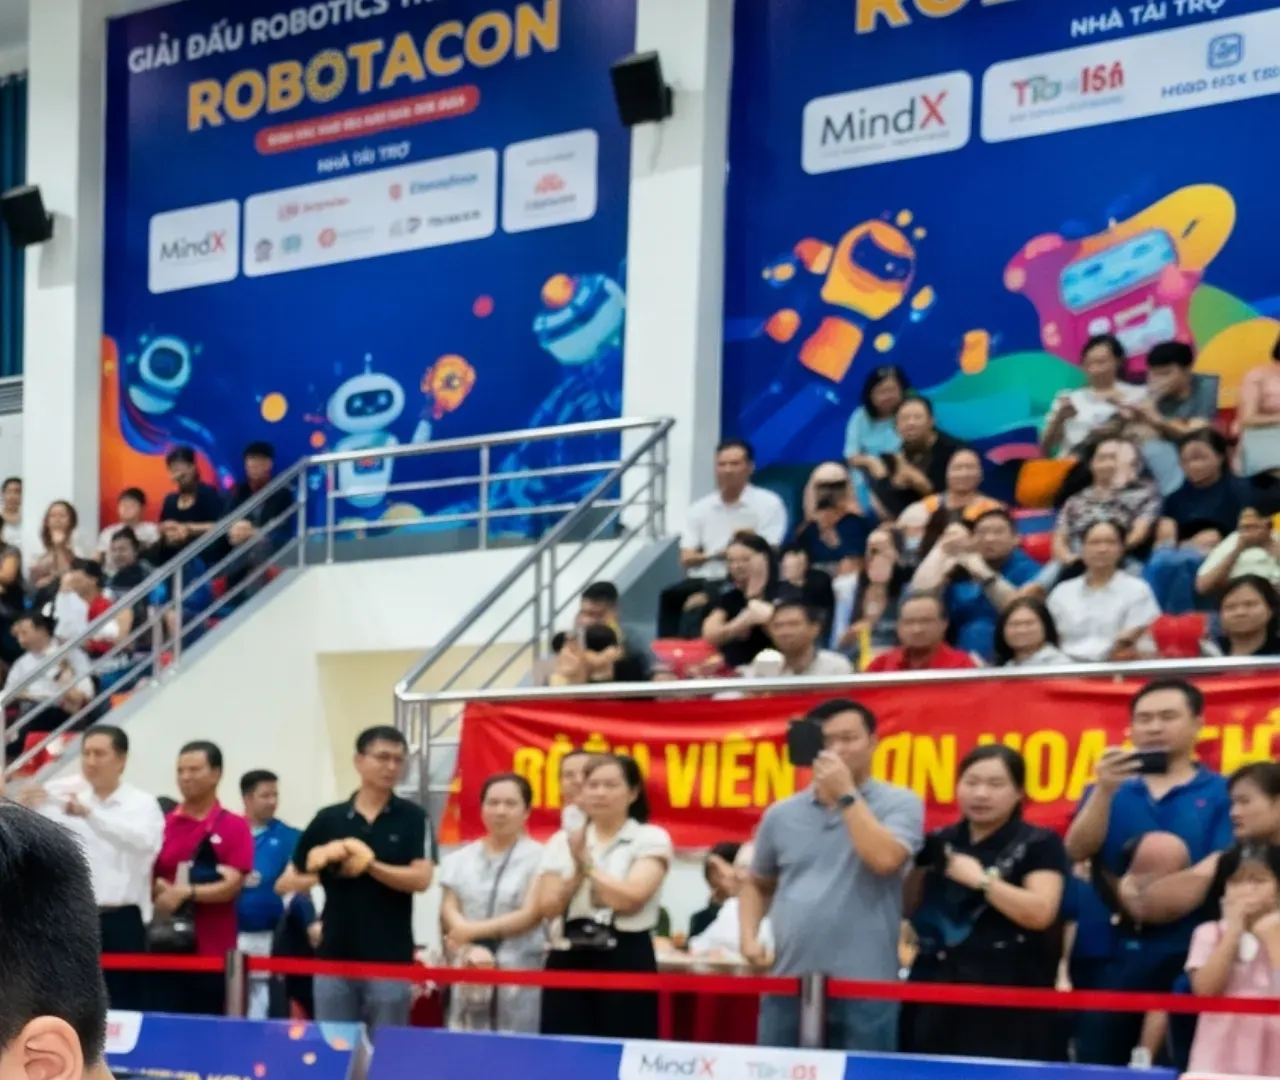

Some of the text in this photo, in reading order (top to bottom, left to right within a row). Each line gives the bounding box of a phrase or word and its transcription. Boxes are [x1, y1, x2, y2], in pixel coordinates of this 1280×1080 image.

[1069, 6, 1124, 37] NHÀ
[187, 0, 562, 131] ROBOTACON
[820, 89, 949, 147] MindX
[160, 230, 226, 263] MindX
[664, 731, 795, 809] VIÊN
